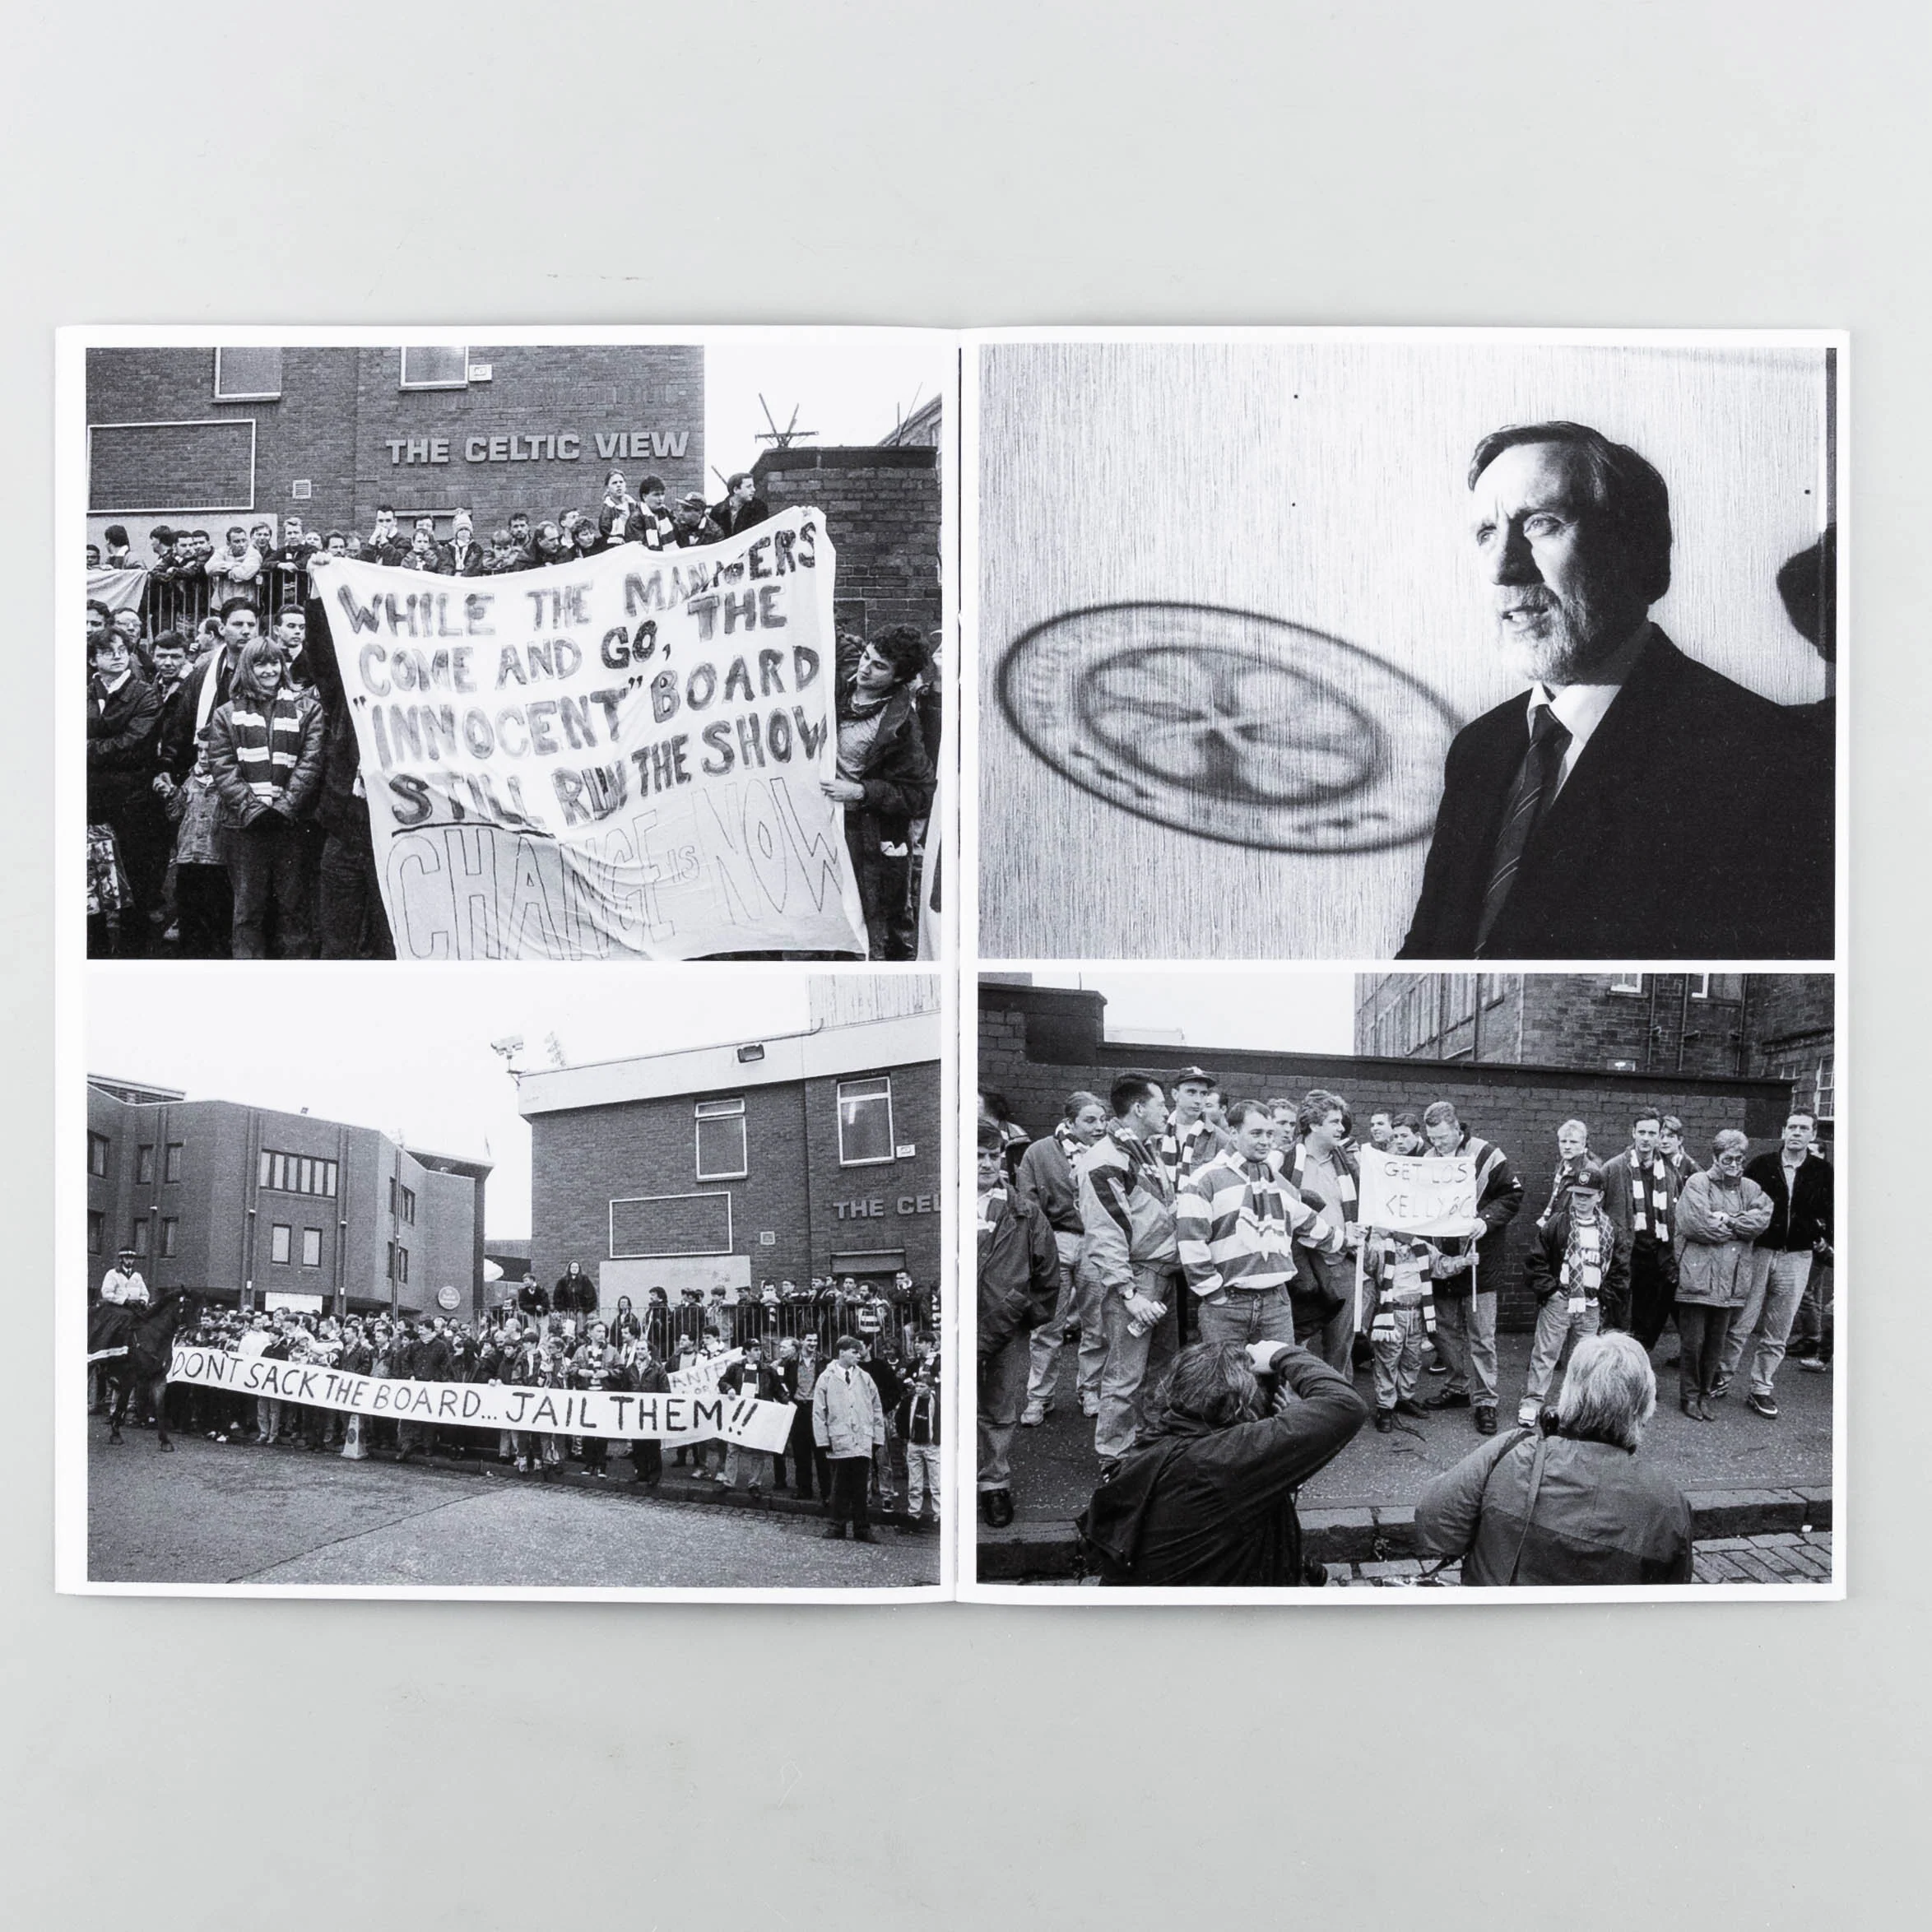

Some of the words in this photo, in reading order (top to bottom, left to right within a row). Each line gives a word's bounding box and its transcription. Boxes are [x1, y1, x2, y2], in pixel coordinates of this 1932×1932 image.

[386, 438, 450, 465] THE
[465, 434, 580, 462] CELTIC
[595, 431, 690, 459] VIEW
[337, 584, 495, 639] WHILE
[526, 579, 593, 632] THE
[359, 643, 477, 697] COME
[495, 638, 583, 691] AND
[687, 585, 787, 642] THE
[650, 645, 820, 724] BOARD
[389, 773, 546, 829] STILL
[631, 734, 692, 796] THE
[701, 705, 828, 777] SHOW
[1384, 1162, 1422, 1182] GET
[833, 1199, 884, 1219] THE
[171, 1350, 244, 1383] DON'T
[244, 1363, 318, 1399] SACK
[326, 1374, 369, 1406] THE
[506, 1392, 597, 1428] JAIL
[609, 1396, 759, 1436] THEM!!
